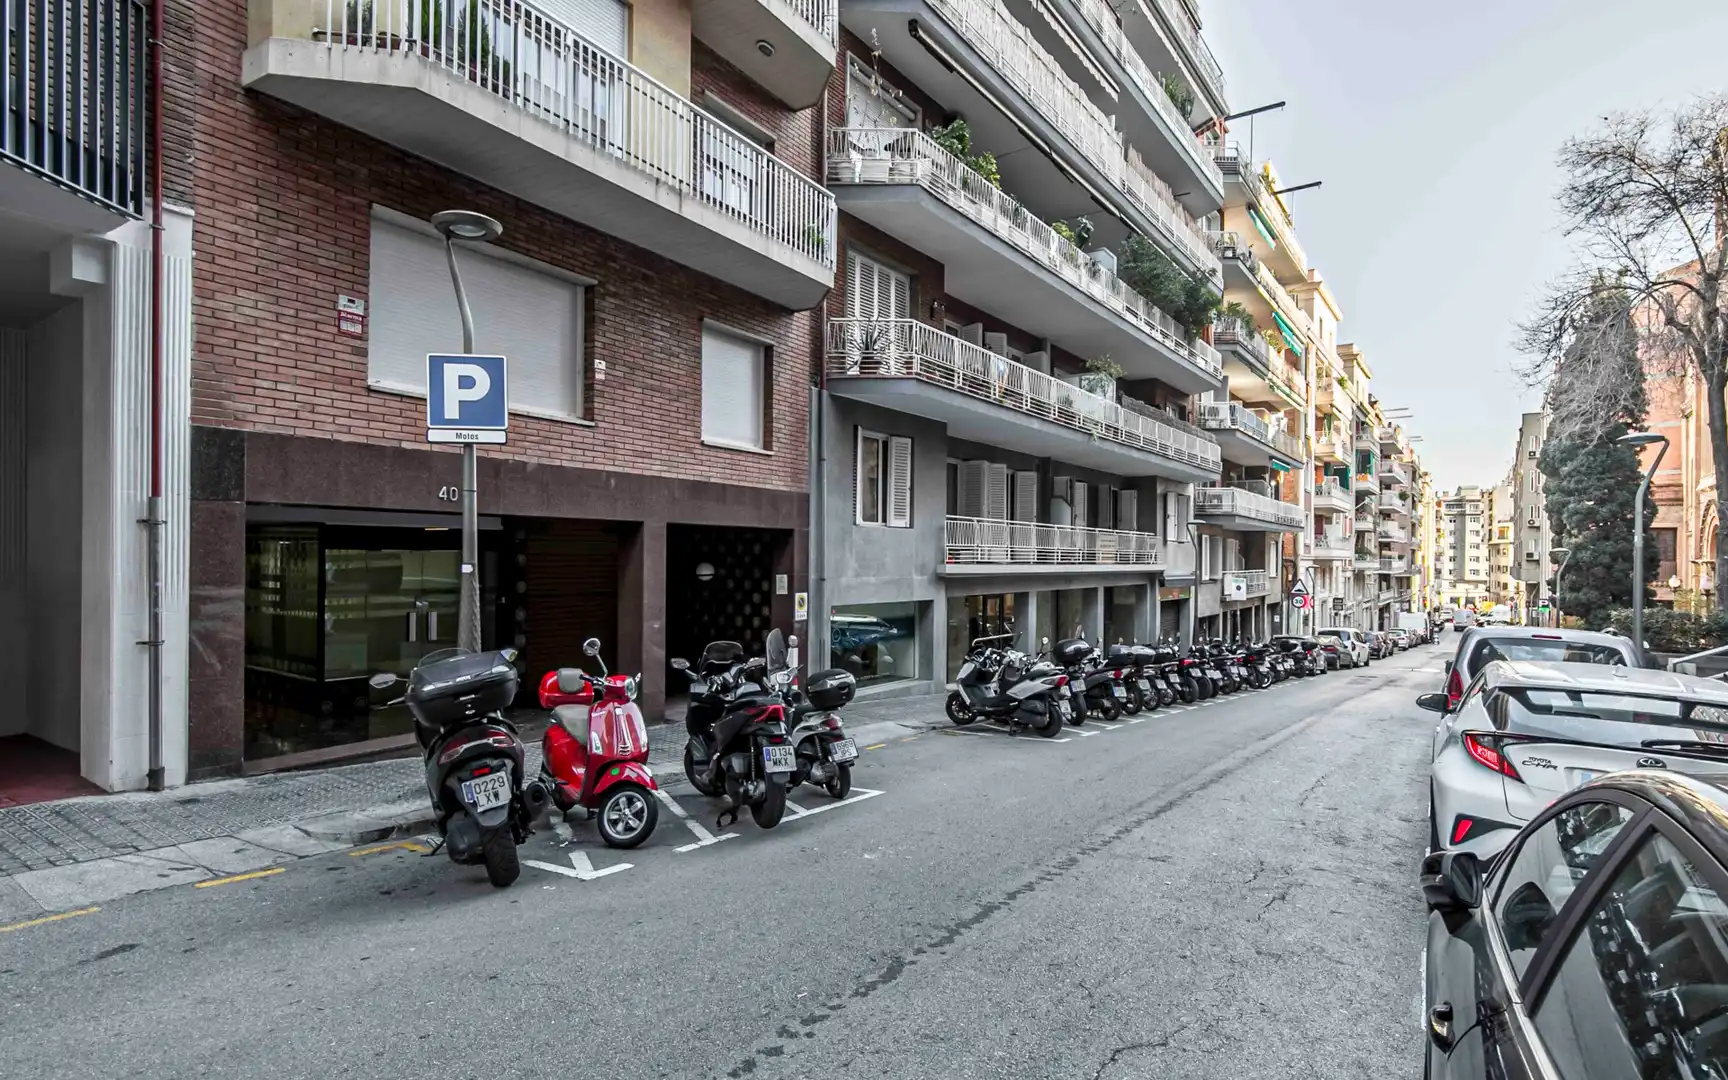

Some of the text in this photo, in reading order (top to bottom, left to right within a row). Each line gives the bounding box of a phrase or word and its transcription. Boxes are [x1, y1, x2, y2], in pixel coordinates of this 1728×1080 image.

[443, 363, 491, 420] P
[455, 432, 479, 441] Motos
[438, 486, 459, 502] 40
[771, 747, 793, 757] 0134
[772, 757, 790, 767] MKX
[1521, 760, 1558, 771] C-HR
[1528, 756, 1552, 764] TOYOTA
[473, 776, 506, 795] 0229
[476, 790, 500, 808] LXW
